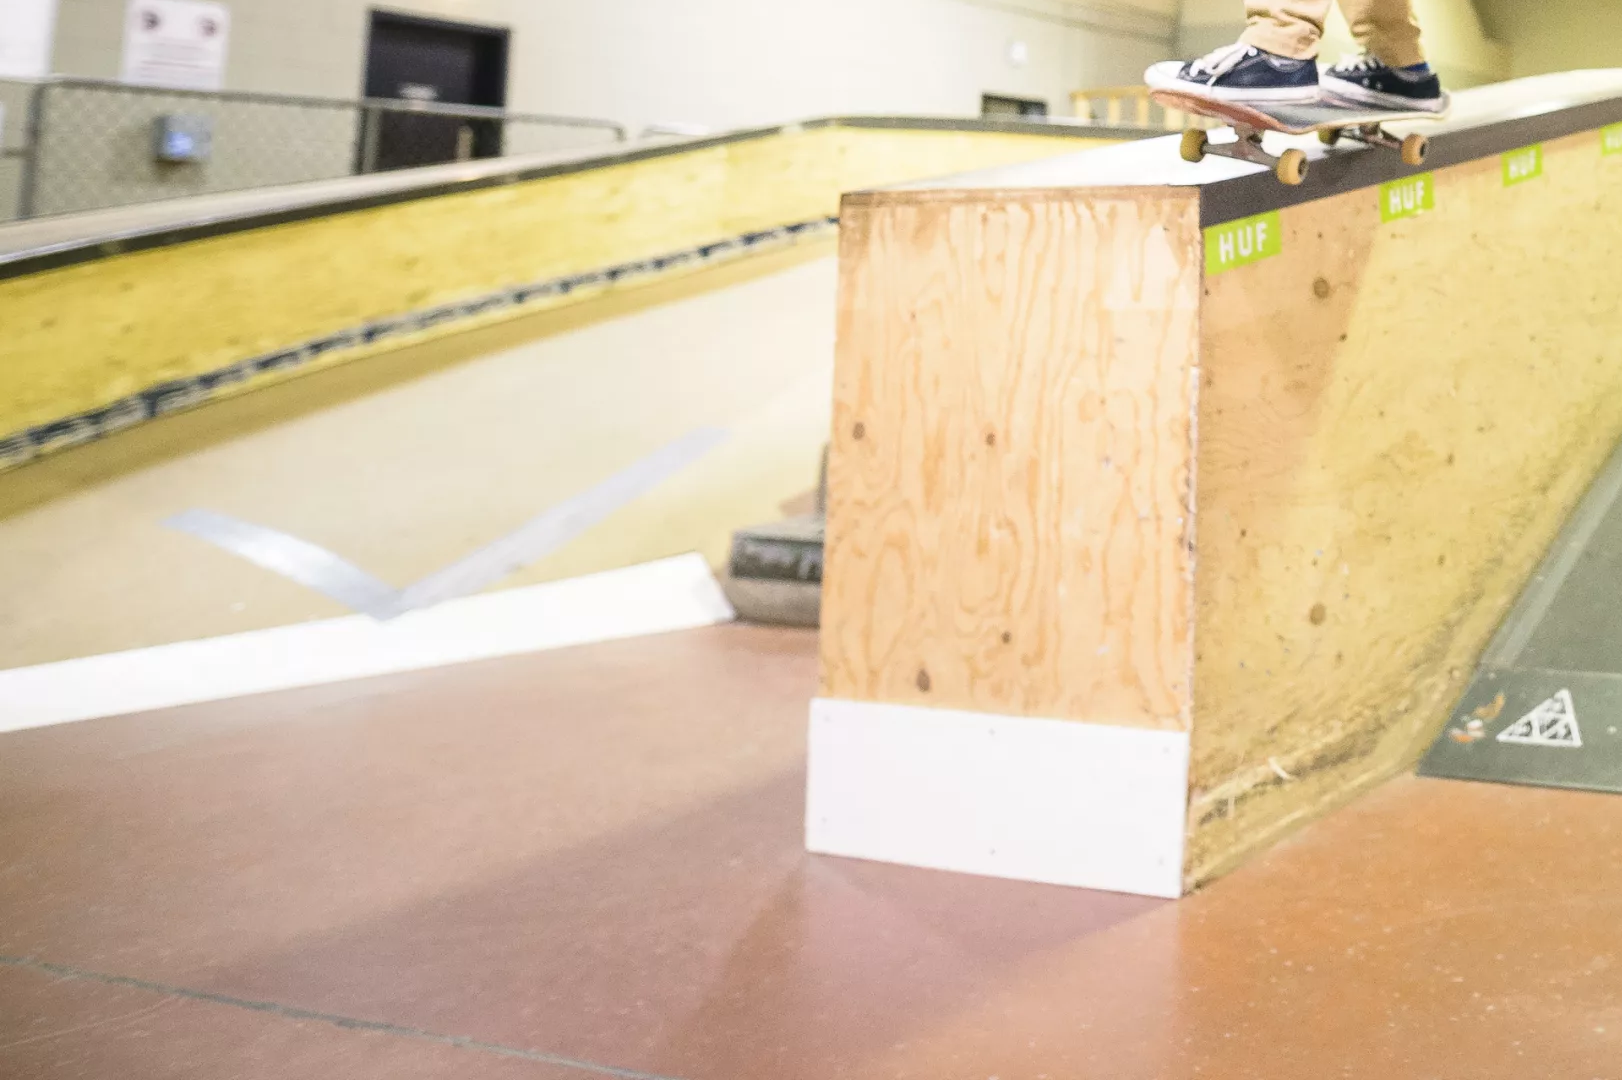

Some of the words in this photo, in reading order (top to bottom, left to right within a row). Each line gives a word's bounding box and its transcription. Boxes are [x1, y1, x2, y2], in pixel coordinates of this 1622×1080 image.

[1509, 150, 1536, 179] HUF
[1389, 180, 1425, 214] HUF
[1219, 221, 1268, 264] HUF
